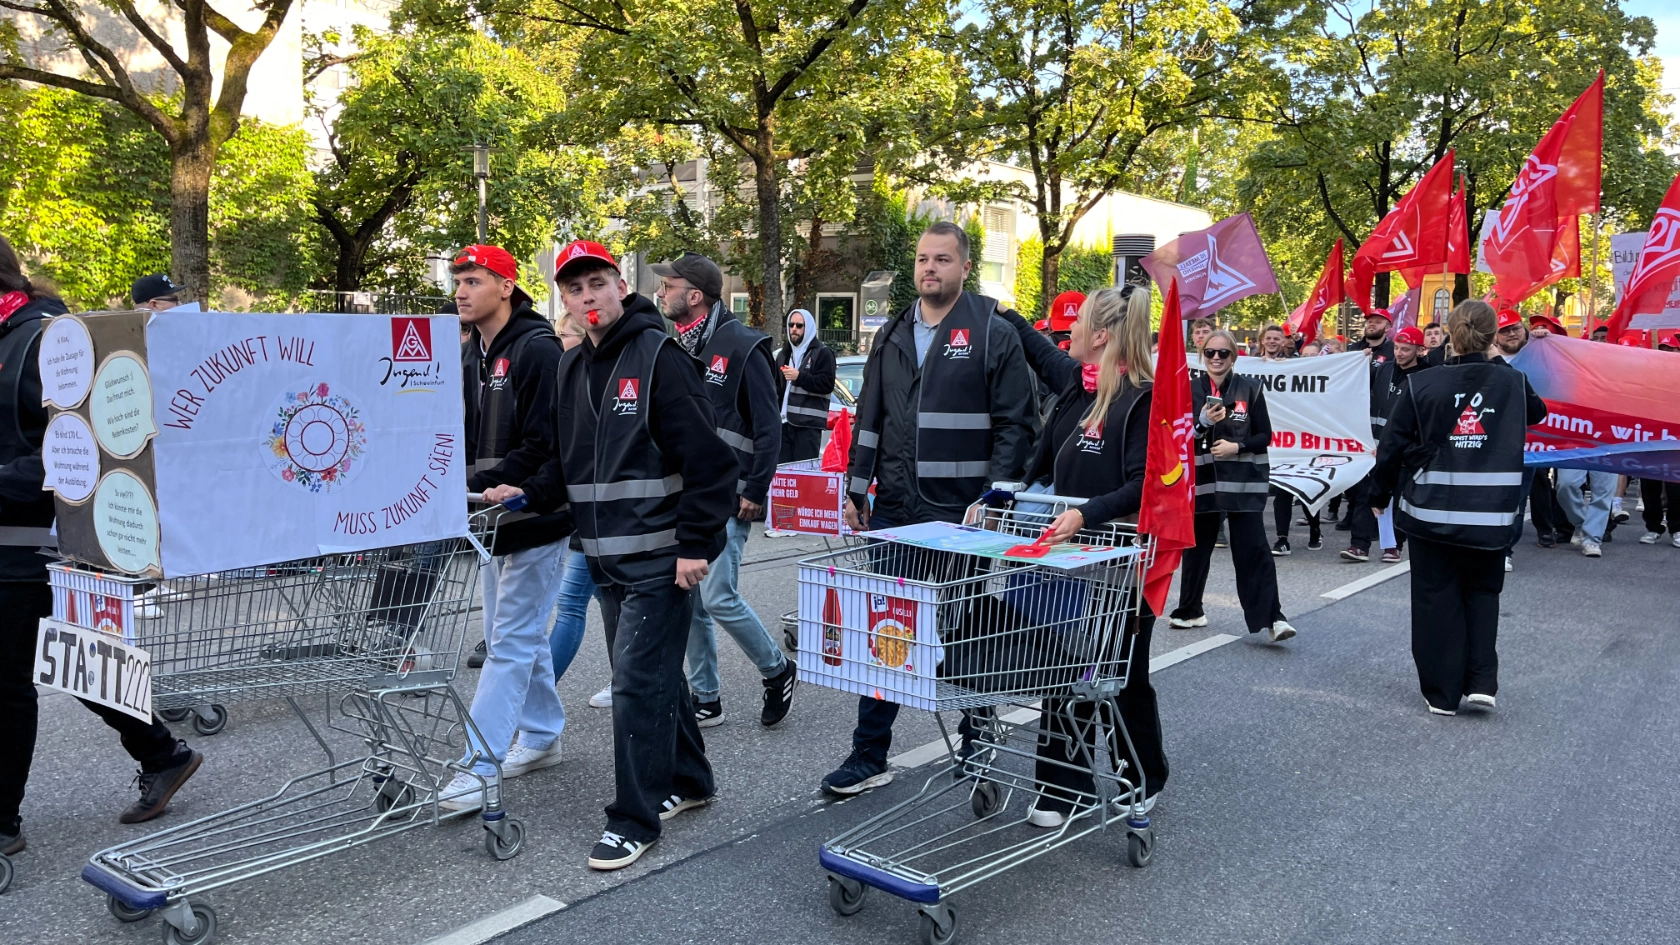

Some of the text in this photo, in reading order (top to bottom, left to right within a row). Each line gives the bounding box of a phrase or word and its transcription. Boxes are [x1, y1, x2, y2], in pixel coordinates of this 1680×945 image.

[163, 335, 315, 430] WER ZUKUNFT WILL
[1290, 375, 1330, 393] MIT
[1610, 423, 1654, 443] wir
[1454, 440, 1483, 449] HITZIG
[428, 433, 455, 476] SÄEN!
[787, 478, 797, 488] ICH
[381, 474, 438, 529] ZUKUNFT
[785, 489, 799, 499] GELD
[814, 508, 824, 518] ICH
[823, 509, 838, 520] MEHR
[333, 511, 377, 535] MUSS
[799, 518, 820, 529] EINKAUF
[873, 595, 886, 610] ja!
